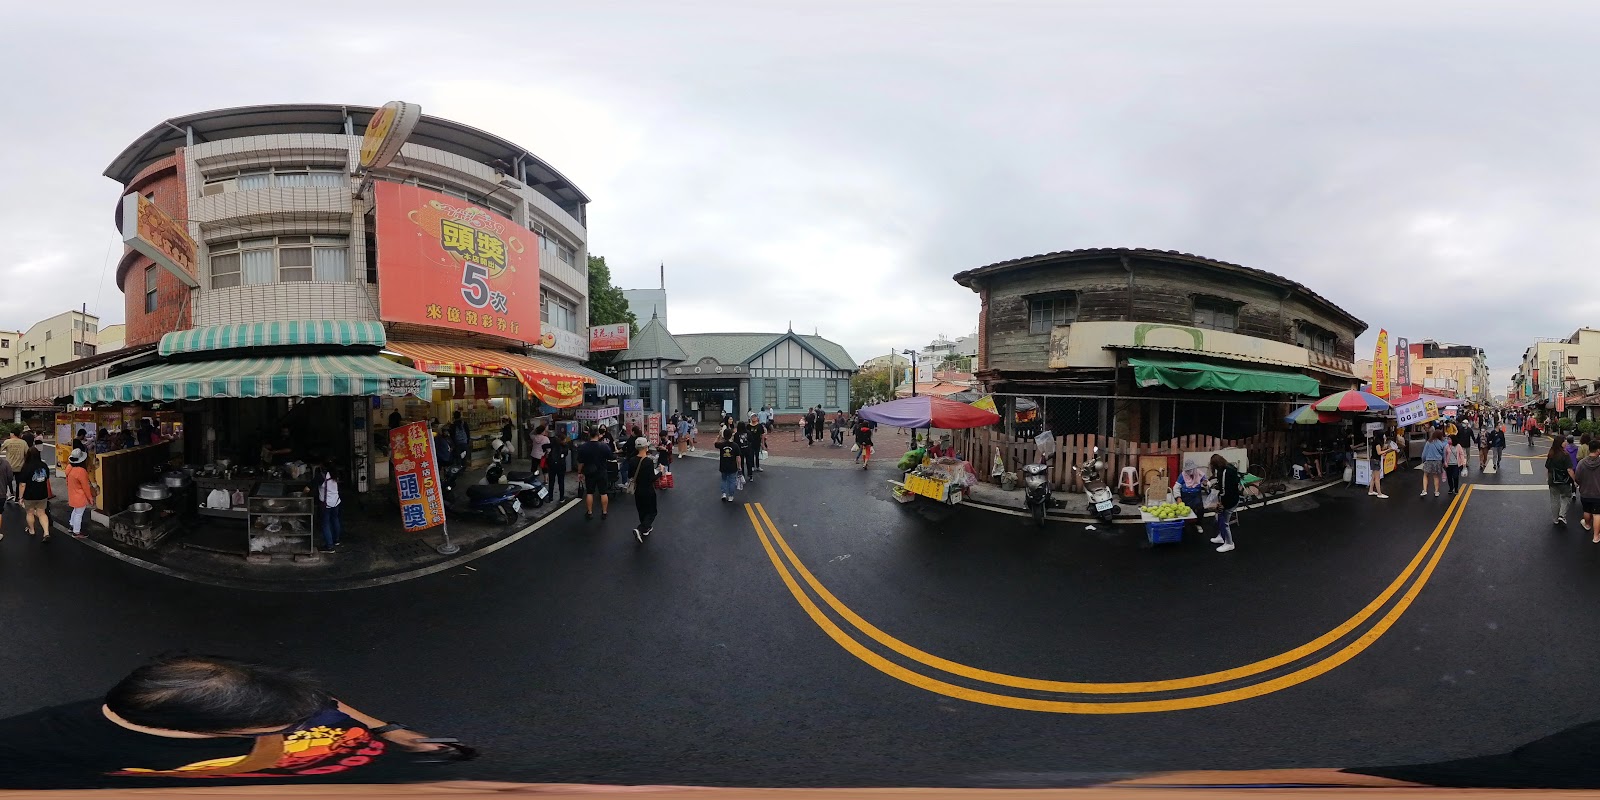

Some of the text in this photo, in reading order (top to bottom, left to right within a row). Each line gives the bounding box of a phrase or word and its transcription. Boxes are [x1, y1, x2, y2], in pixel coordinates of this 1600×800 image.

[442, 220, 504, 265] 頭獎
[463, 252, 495, 269] 本店開出
[426, 303, 519, 334] 來億發彩券行
[409, 425, 425, 458] 狂賀
[398, 473, 427, 529] 頭獎
